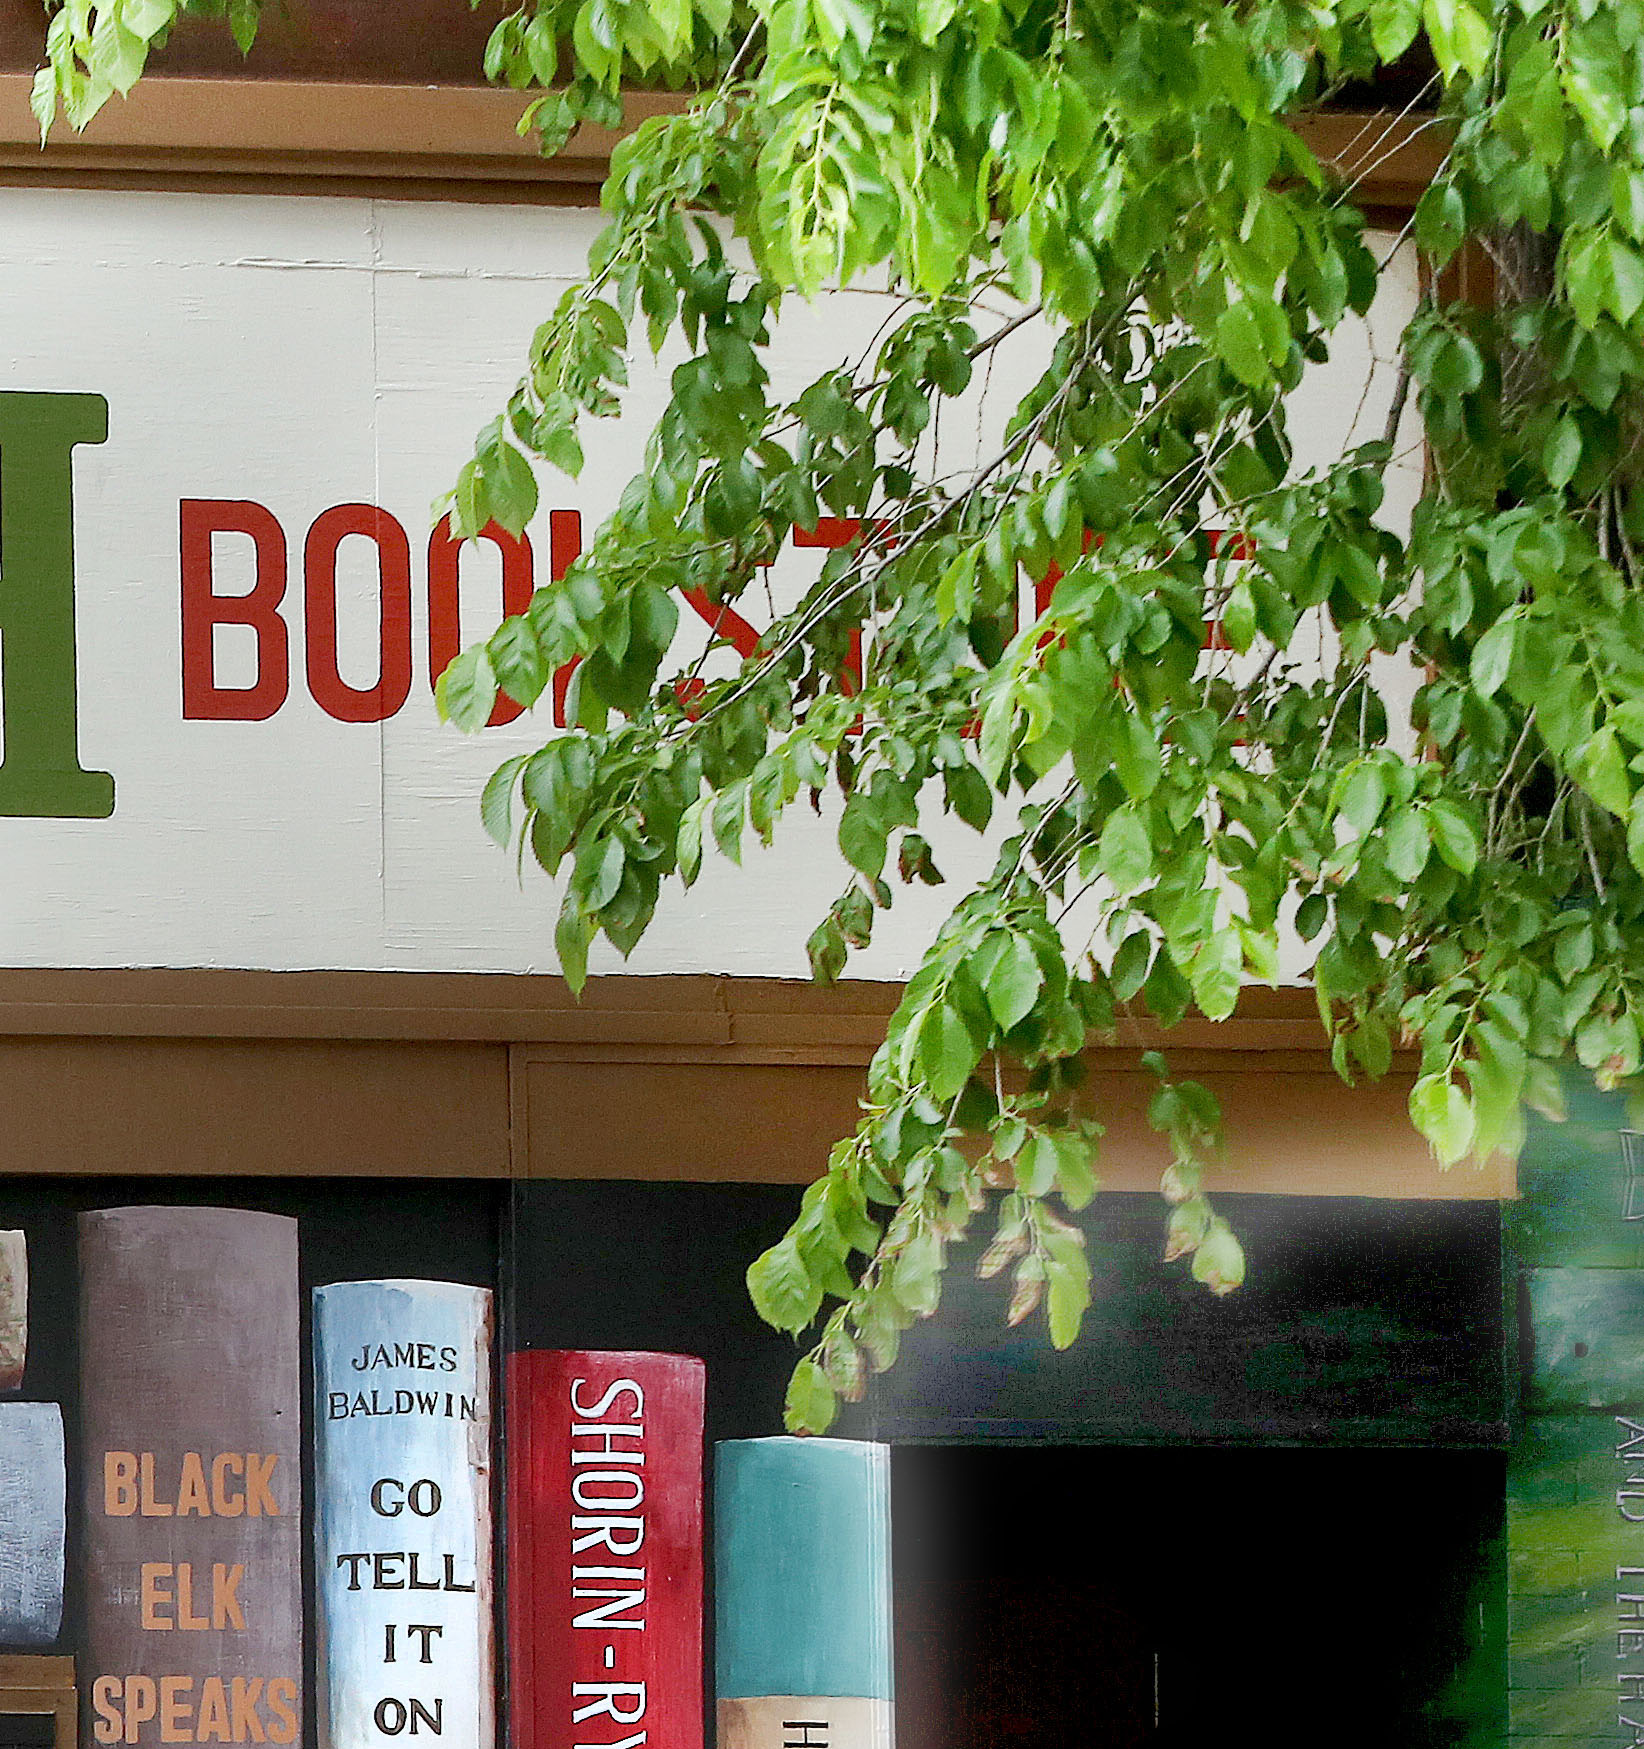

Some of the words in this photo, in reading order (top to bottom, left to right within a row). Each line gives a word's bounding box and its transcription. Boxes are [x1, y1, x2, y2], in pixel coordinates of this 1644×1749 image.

[350, 1343, 458, 1373] JAMES
[328, 1390, 478, 1422] BALDWIN
[104, 1450, 280, 1517] BLACK
[371, 1478, 442, 1518] GO
[337, 1552, 476, 1592] TELL
[140, 1562, 247, 1632] ELK
[383, 1625, 443, 1664] IT
[92, 1675, 298, 1745] SPEAKS
[373, 1698, 443, 1736] ON
